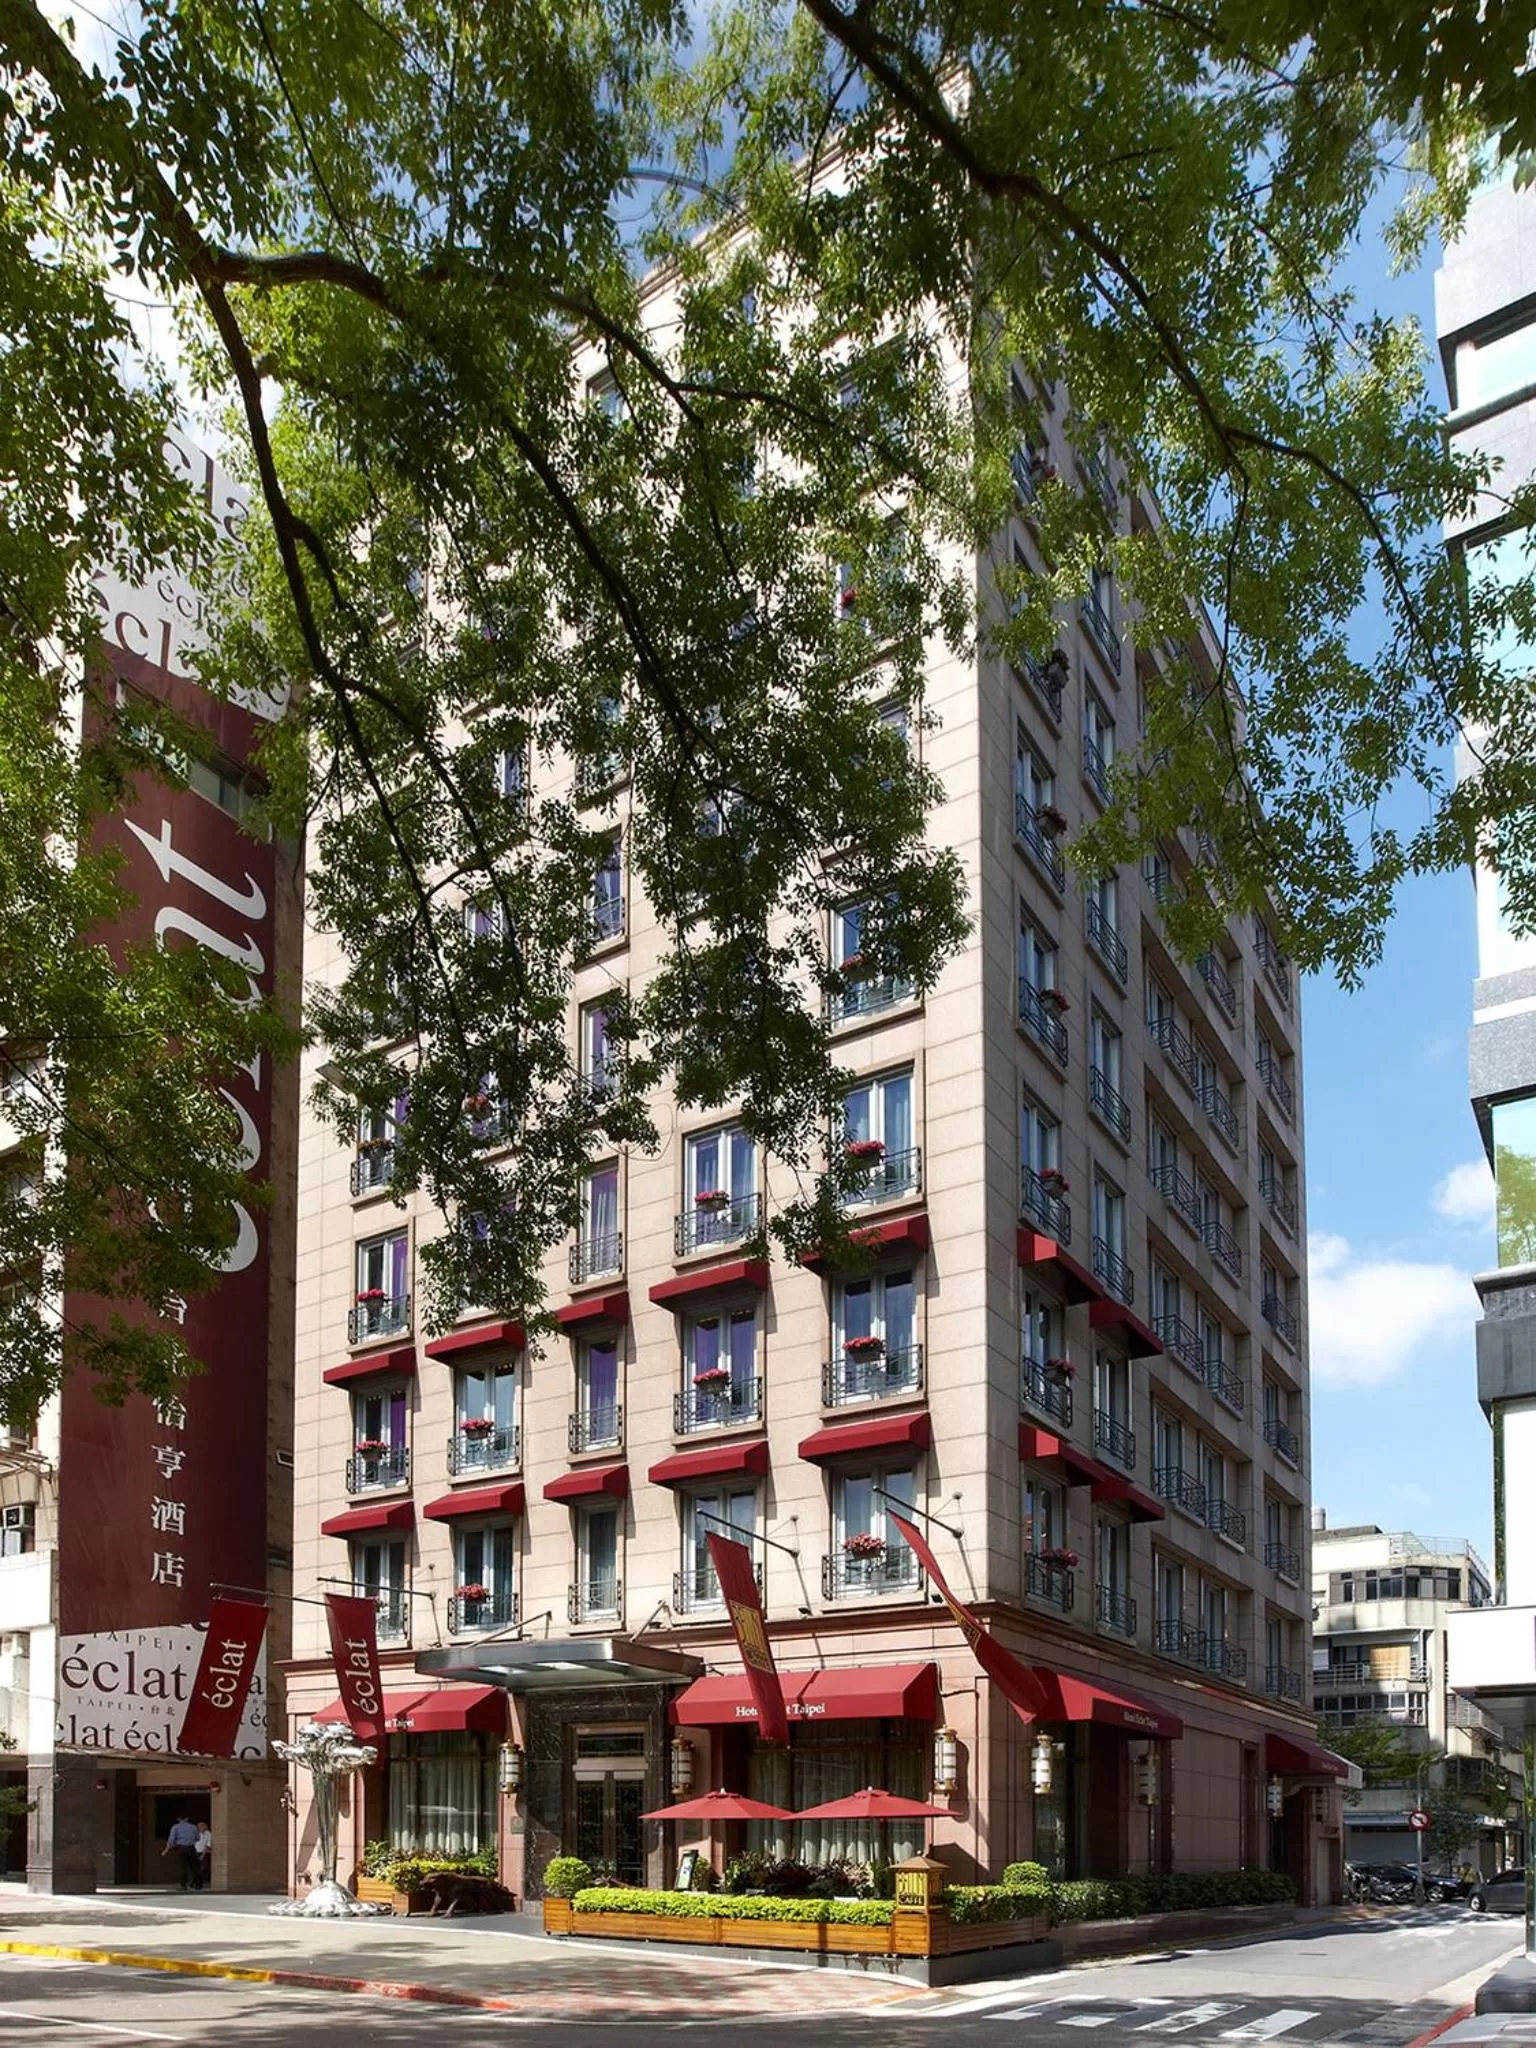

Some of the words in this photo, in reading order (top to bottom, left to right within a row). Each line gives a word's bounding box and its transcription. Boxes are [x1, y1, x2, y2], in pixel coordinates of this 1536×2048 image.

[61, 1642, 188, 1702] éclat
[201, 1638, 248, 1710] éclat
[345, 1637, 380, 1716] éclat
[76, 1695, 133, 1712] TAIPEI
[791, 1702, 826, 1718] Taipei
